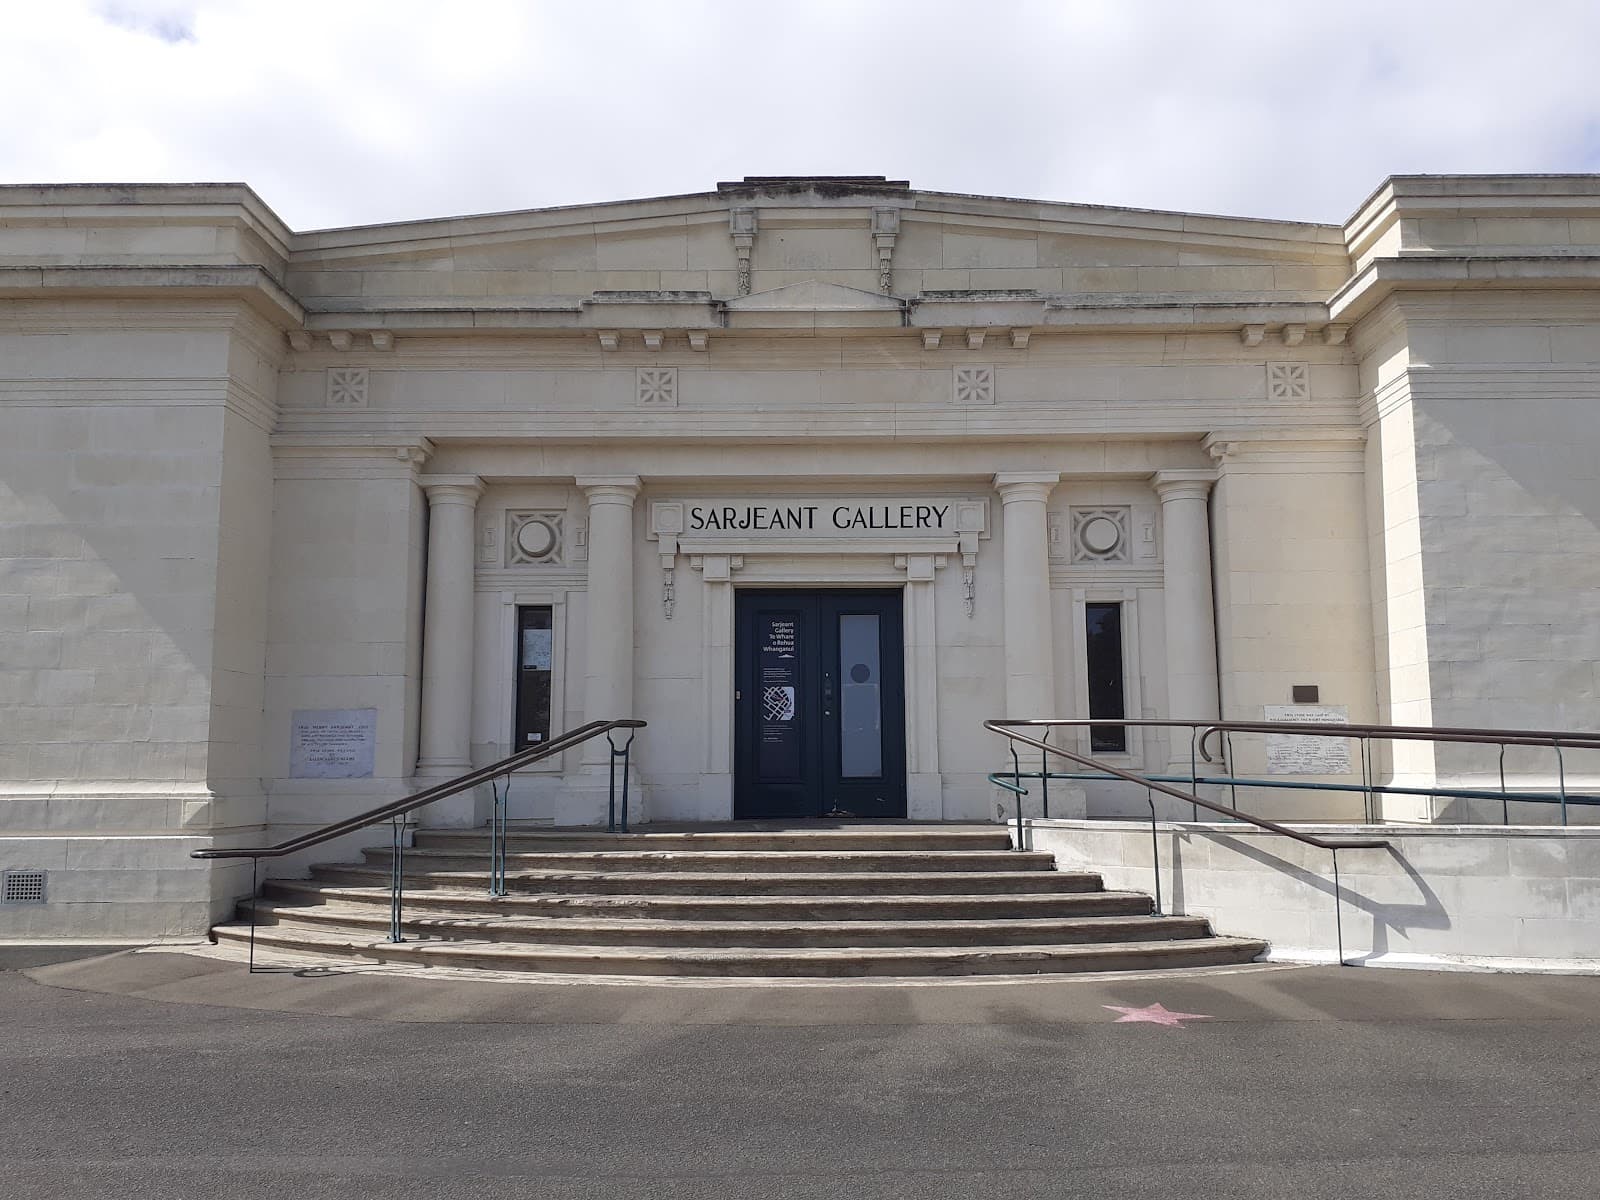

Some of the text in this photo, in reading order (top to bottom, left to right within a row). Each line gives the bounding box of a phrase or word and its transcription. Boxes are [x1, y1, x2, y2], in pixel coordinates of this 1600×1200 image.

[690, 505, 949, 530] SARJEANT GALLERY
[774, 626, 794, 634] Gallery
[763, 645, 794, 653] Whanganui
